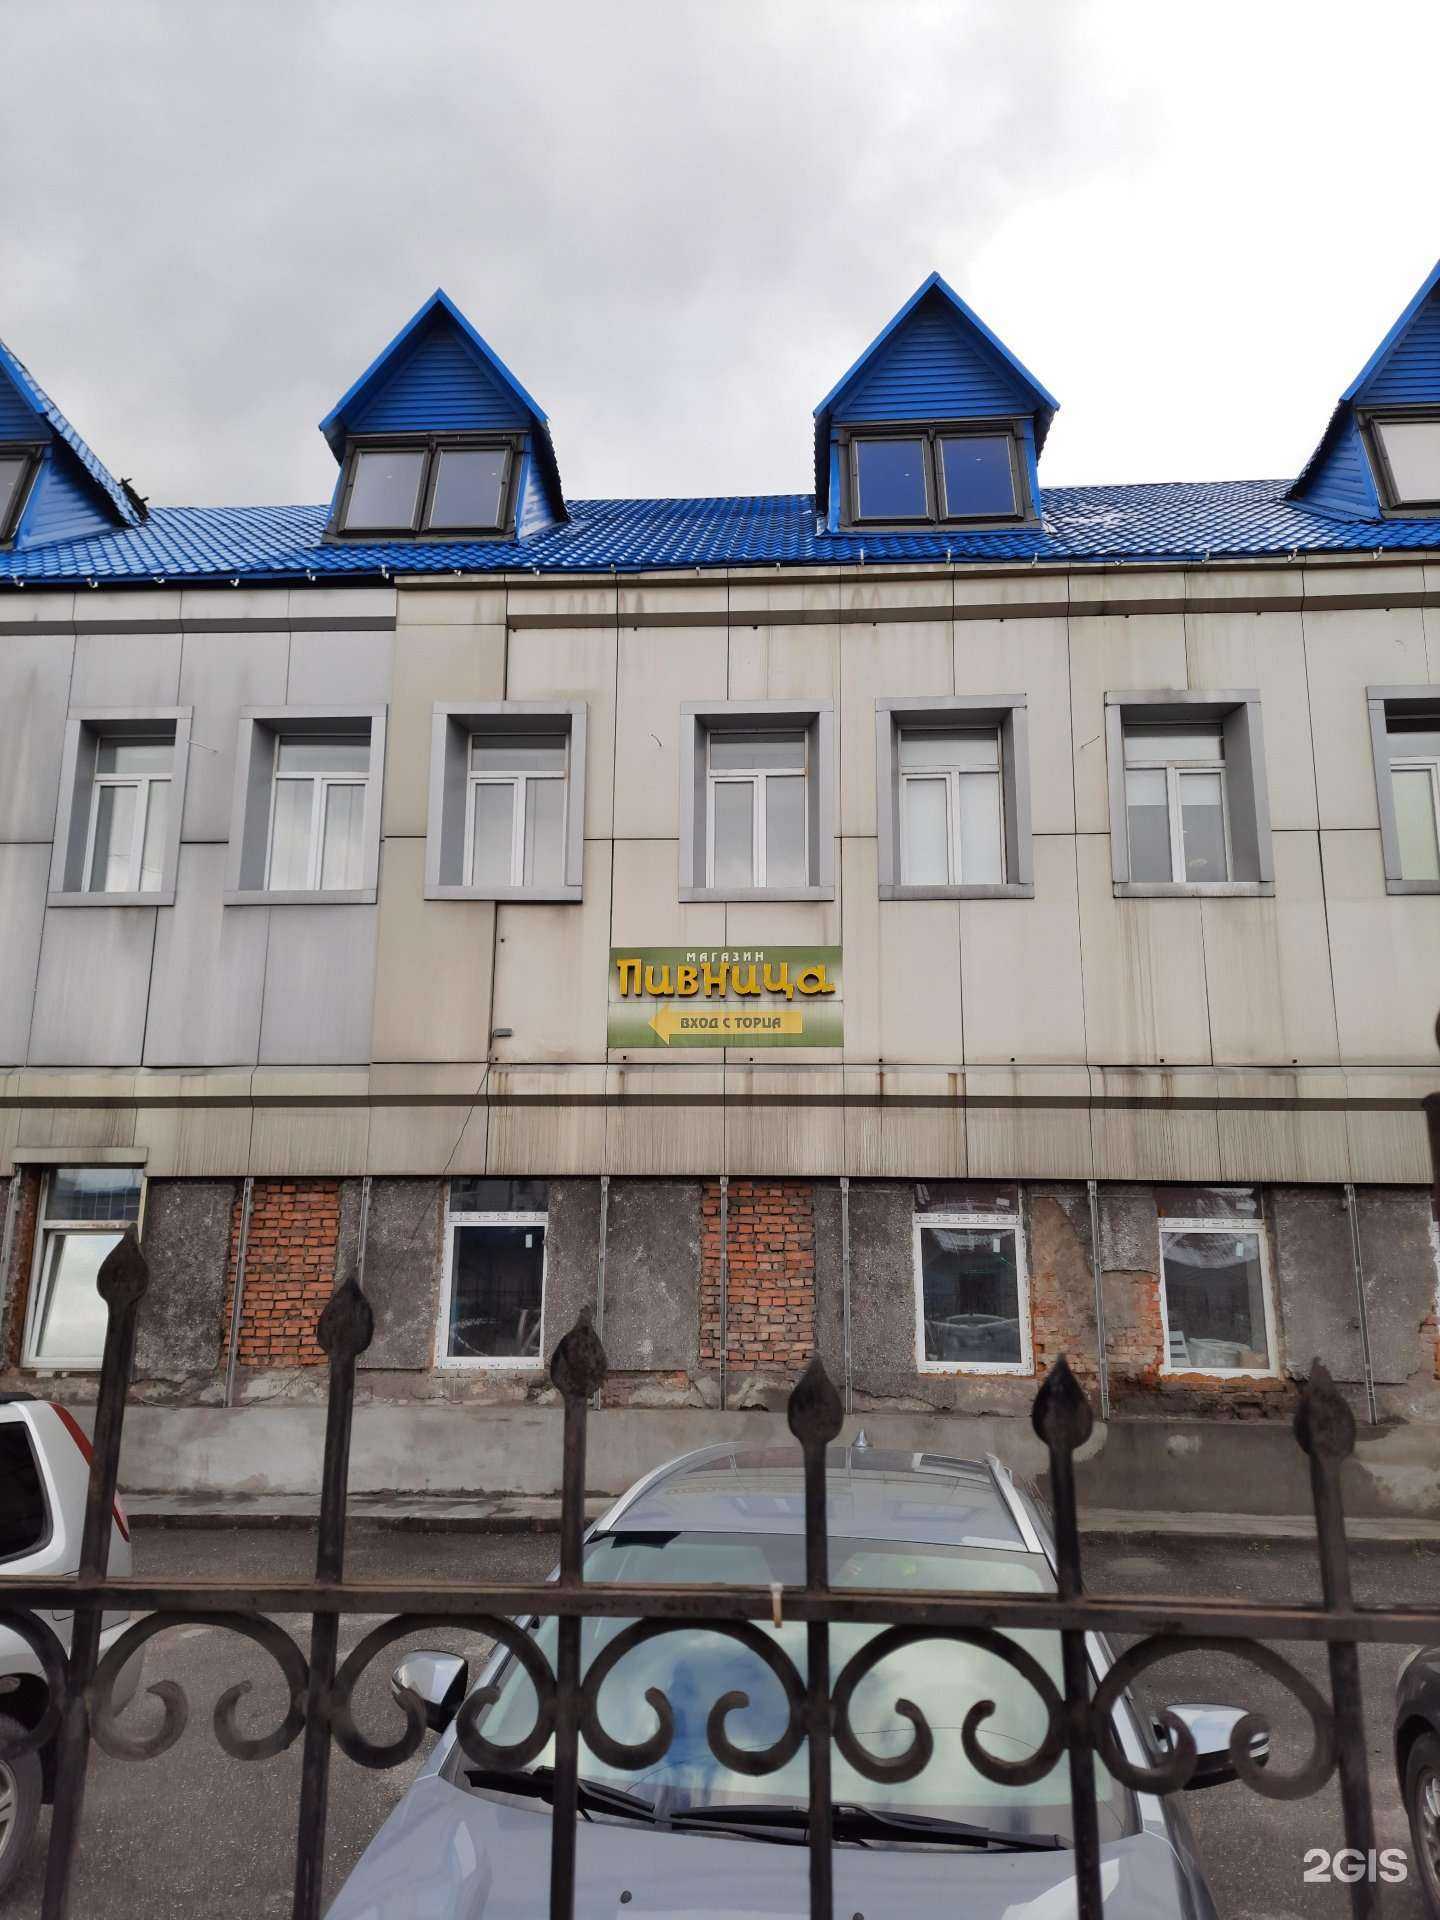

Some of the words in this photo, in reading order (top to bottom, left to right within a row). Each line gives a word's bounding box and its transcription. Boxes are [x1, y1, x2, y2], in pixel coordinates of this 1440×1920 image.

[686, 952, 764, 962] МАГАЗИН
[680, 1017, 719, 1029] ВХОД
[722, 1017, 731, 1029] С
[734, 1017, 781, 1029] ТОРЦА
